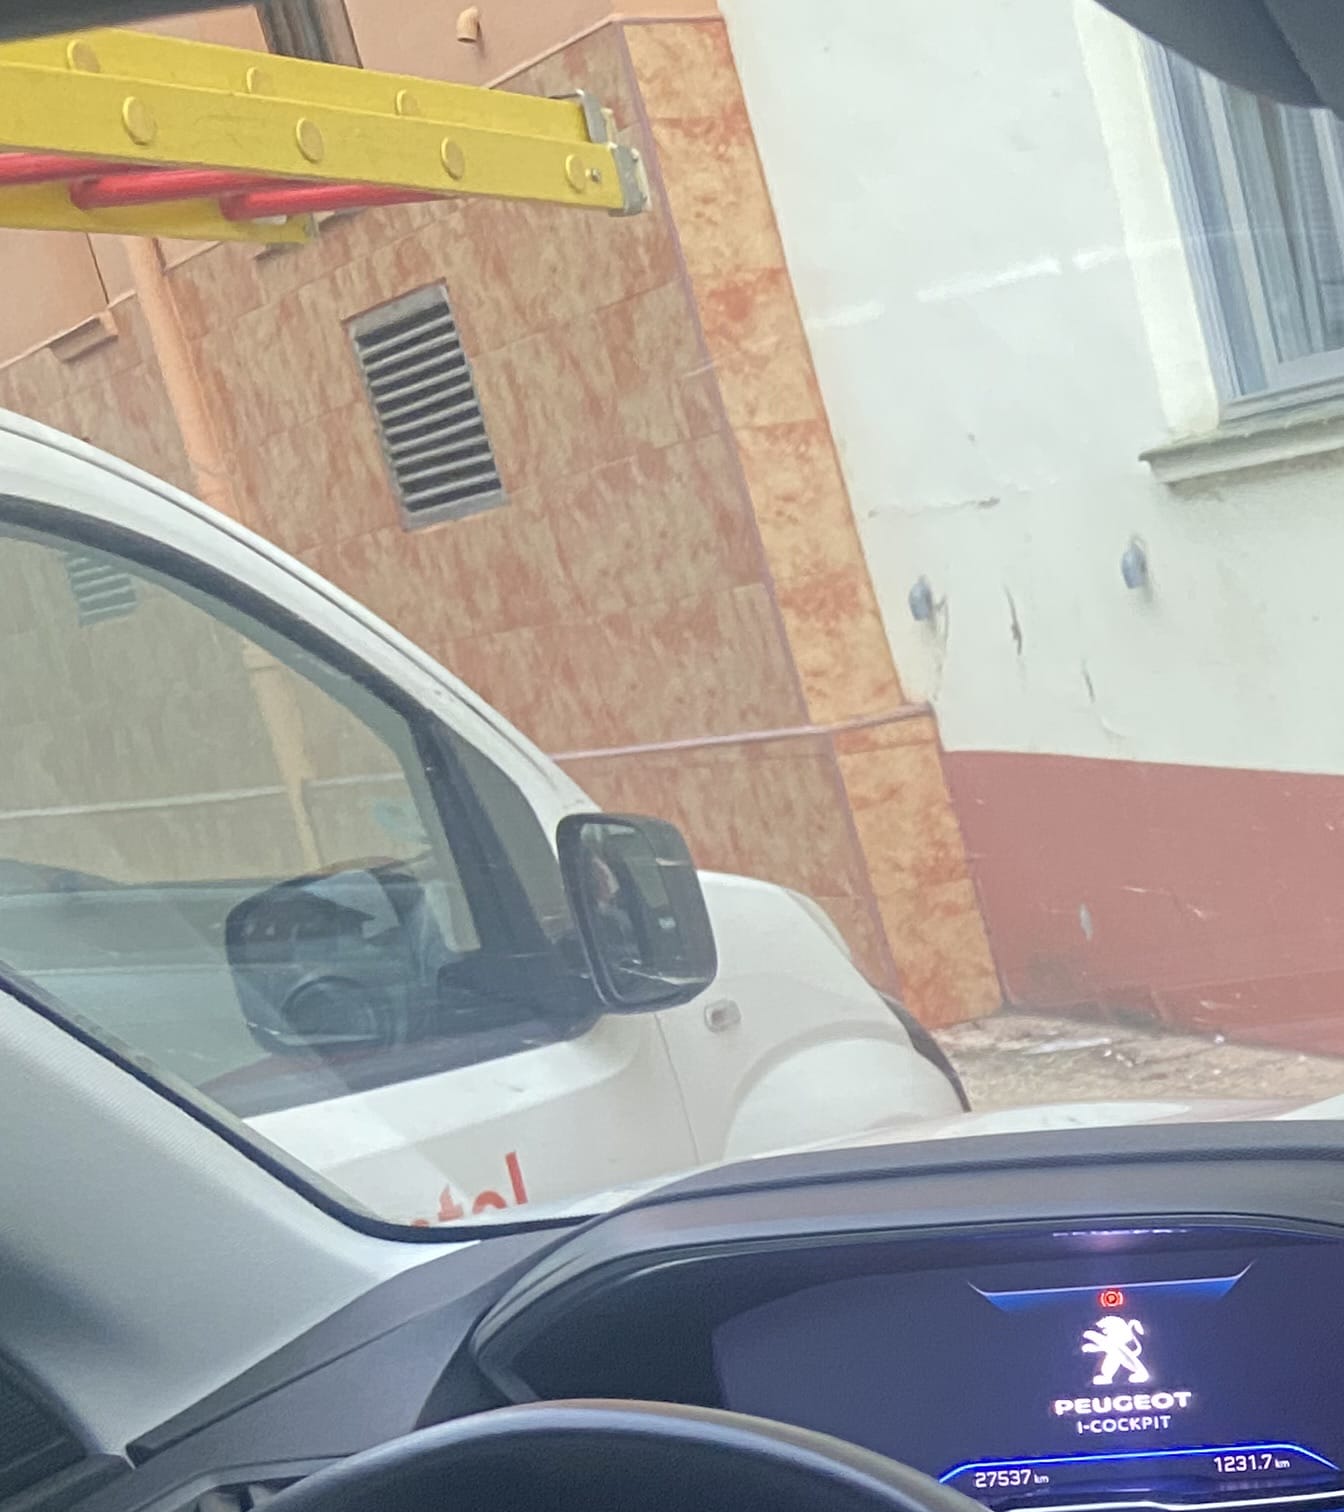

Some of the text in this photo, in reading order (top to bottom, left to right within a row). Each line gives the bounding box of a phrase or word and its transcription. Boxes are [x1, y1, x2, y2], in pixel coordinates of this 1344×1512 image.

[1055, 1390, 1192, 1416] PEUGEOT
[1213, 1453, 1273, 1472] 1231.7
[975, 1469, 1049, 1488] 27537 km
